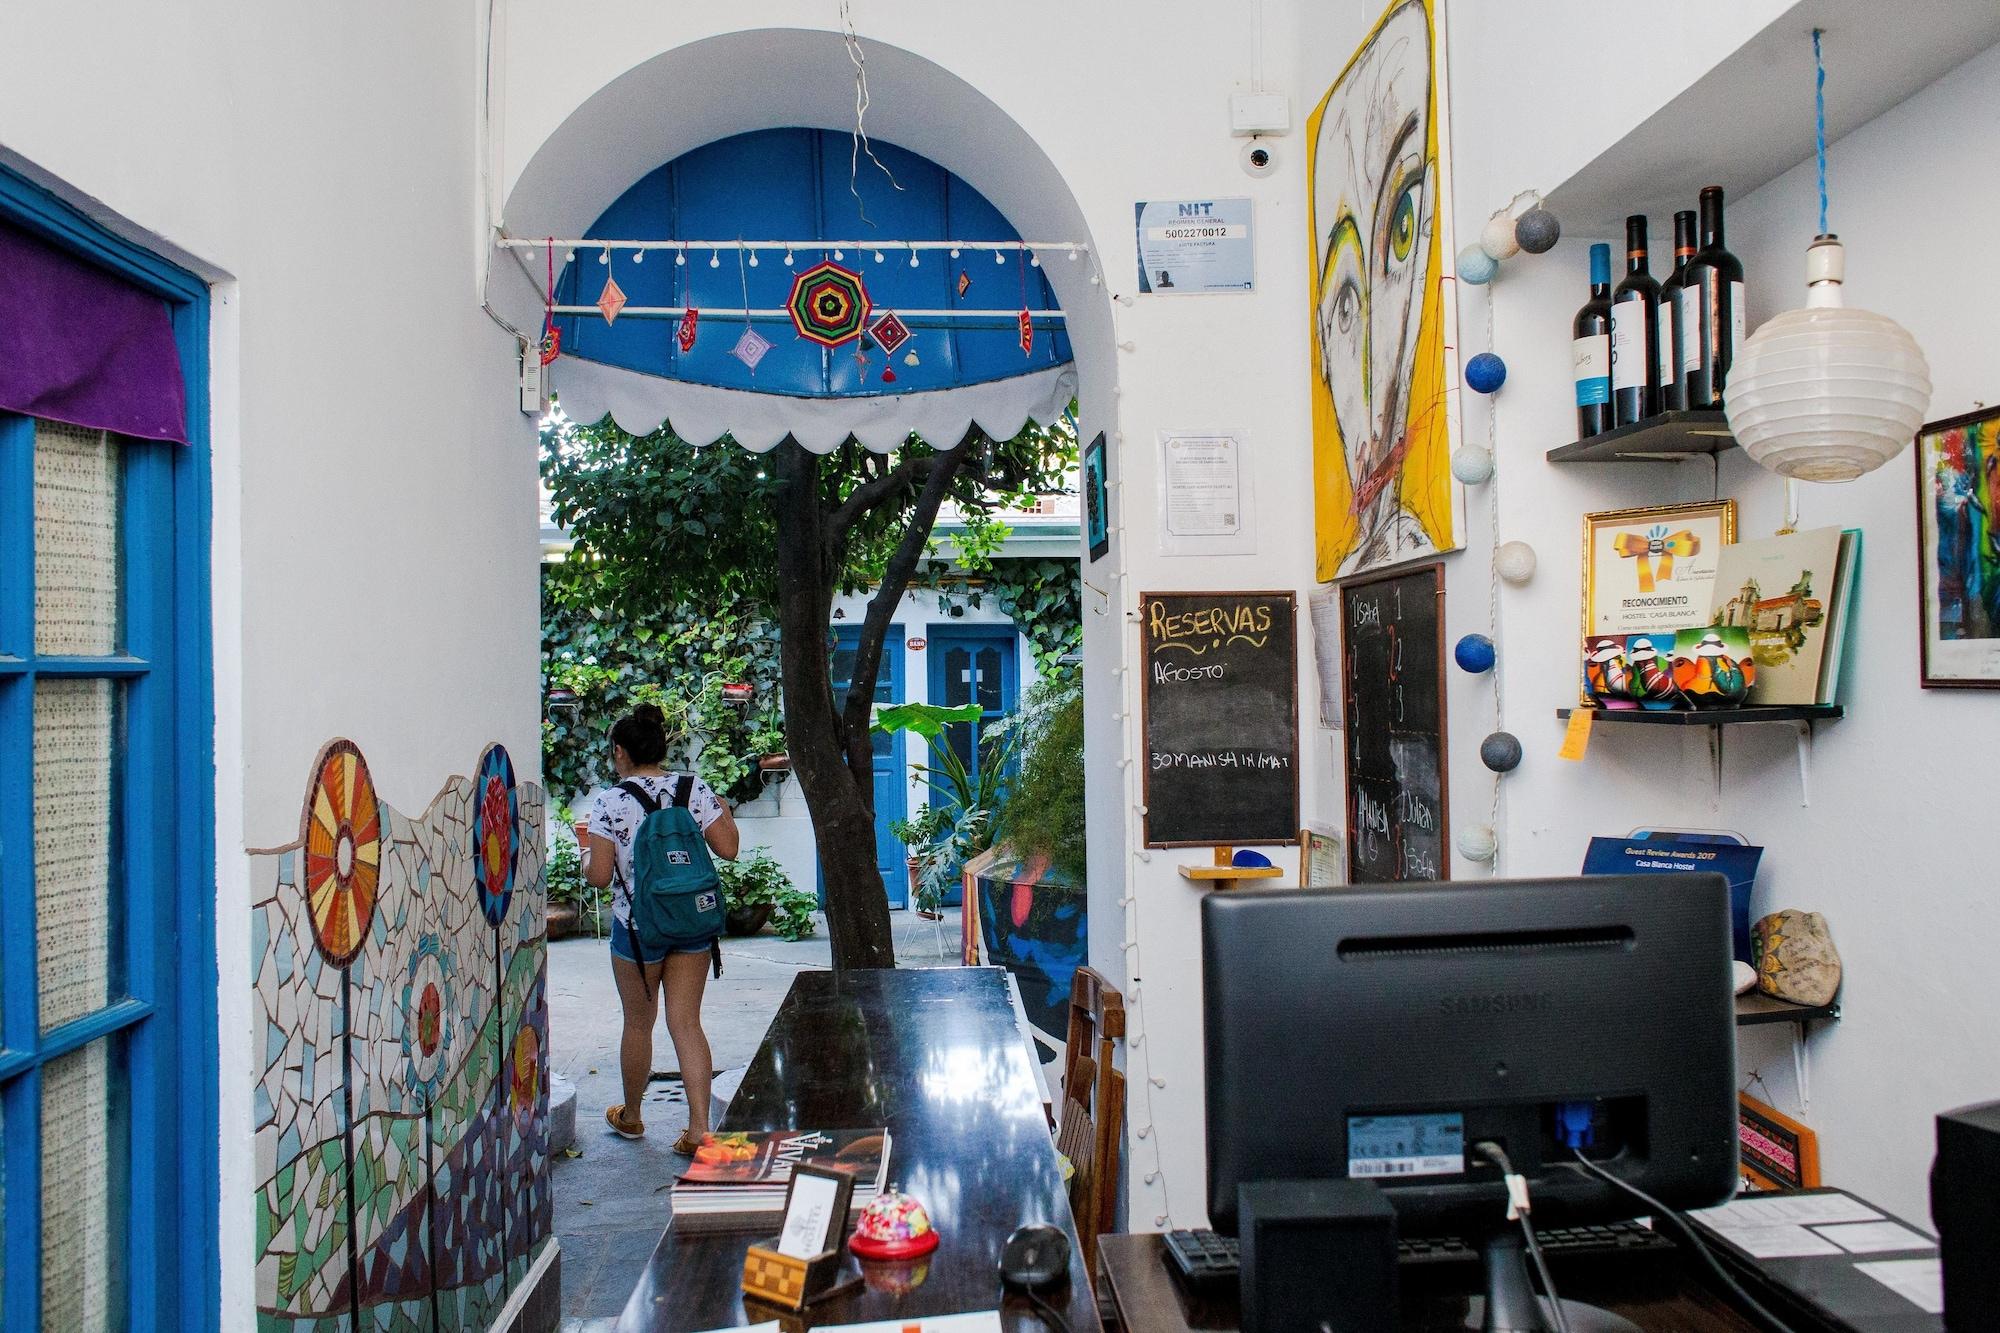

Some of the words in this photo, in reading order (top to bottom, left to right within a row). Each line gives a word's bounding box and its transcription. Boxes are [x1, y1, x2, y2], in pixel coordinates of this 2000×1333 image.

[1178, 203, 1213, 217] NIT
[1165, 227, 1227, 239] 5002270012
[1622, 595, 1688, 608] RECONOCIMIENTO
[1150, 601, 1271, 641] RESERVAS
[1622, 612, 1647, 620] HOSTEL
[1154, 661, 1224, 685] AGOSTO
[1625, 847, 1646, 856] Guest
[1646, 848, 1670, 857] Review
[1670, 851, 1696, 859] Awards
[1697, 852, 1716, 860] 2017
[1651, 861, 1672, 869] Blanca
[1673, 862, 1695, 871] Hostel
